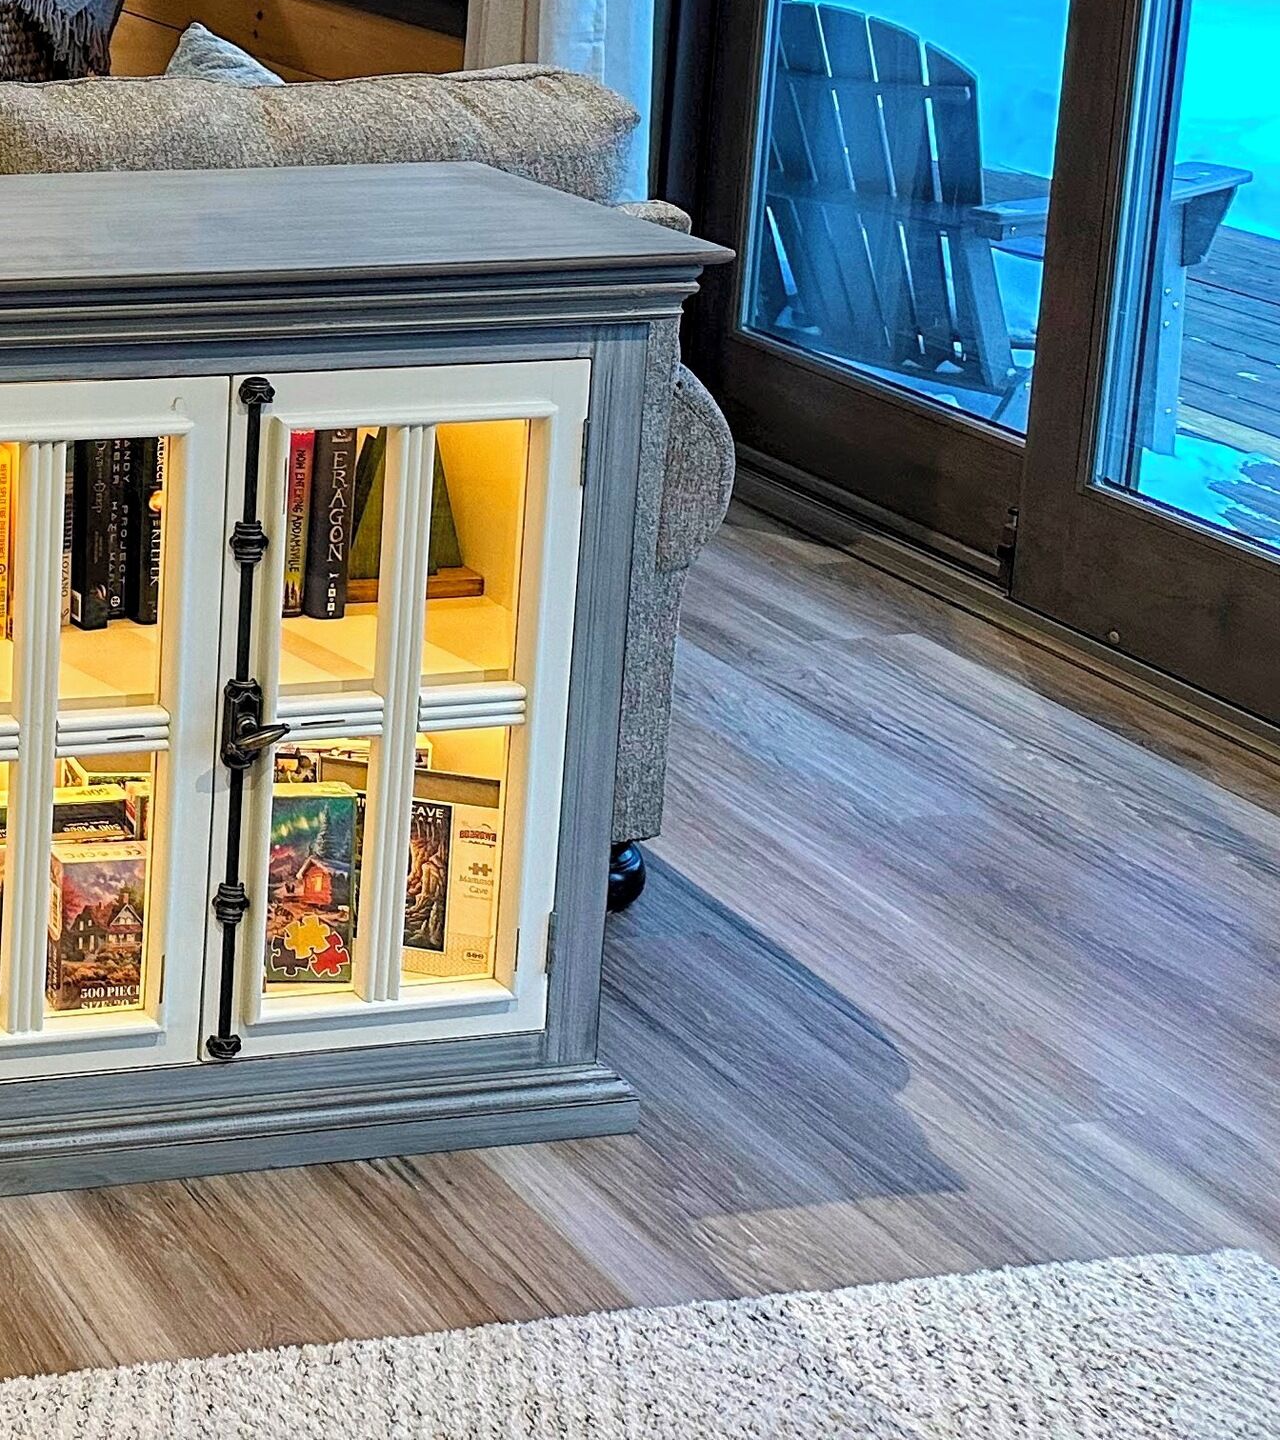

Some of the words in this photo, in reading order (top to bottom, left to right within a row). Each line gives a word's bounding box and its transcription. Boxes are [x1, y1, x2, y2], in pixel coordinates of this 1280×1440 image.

[122, 440, 131, 484] ANDY
[156, 436, 166, 482] ALDACCI
[296, 449, 307, 471] NOW
[0, 486, 7, 504] SPLIT
[292, 472, 305, 513] ENTERING
[326, 450, 349, 563] ERAGON
[107, 501, 118, 543] HAIL
[118, 505, 129, 585] PROJECT
[288, 514, 303, 573] ADDAMSVILLE
[107, 552, 117, 594] MARY
[459, 875, 494, 887] Mammot
[469, 885, 488, 895] Cave
[80, 987, 104, 999] 500
